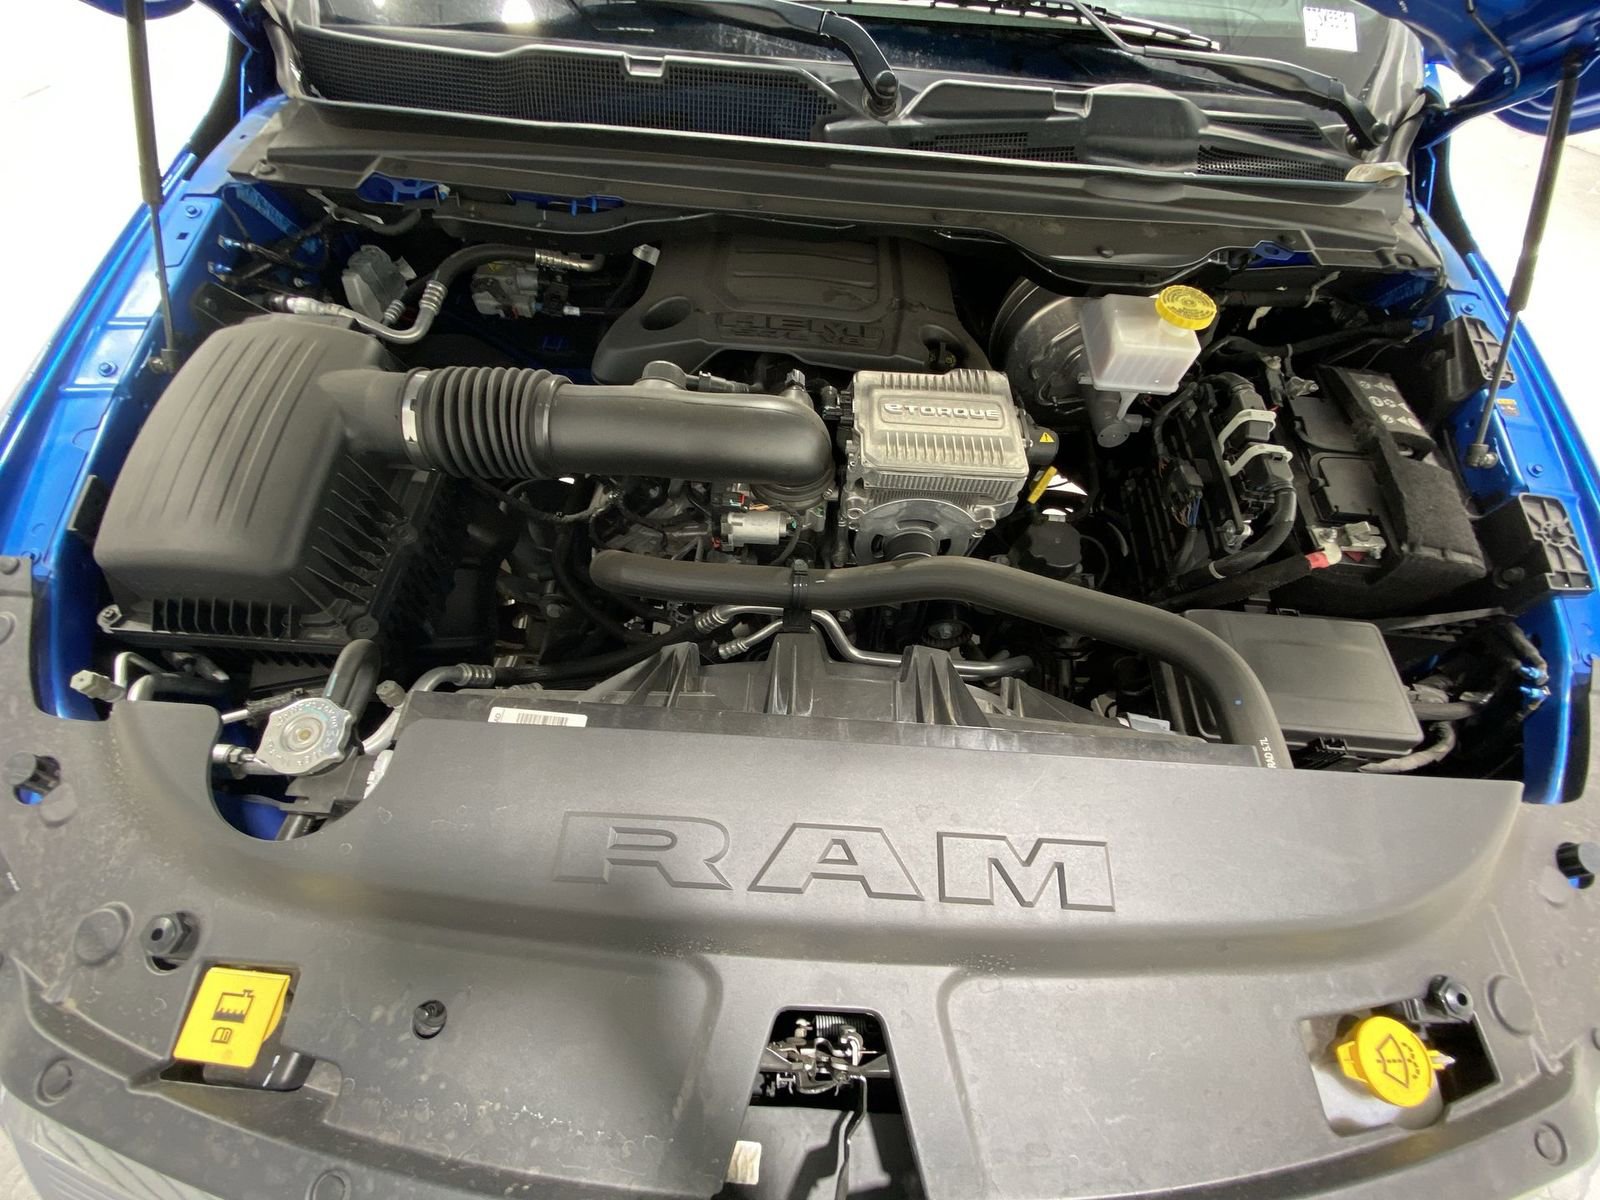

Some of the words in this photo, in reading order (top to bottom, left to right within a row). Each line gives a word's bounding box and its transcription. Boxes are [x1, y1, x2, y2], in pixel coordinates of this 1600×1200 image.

[884, 403, 1000, 421] eTORQUE
[1263, 752, 1277, 769] RAD
[553, 811, 1116, 912] RAM
